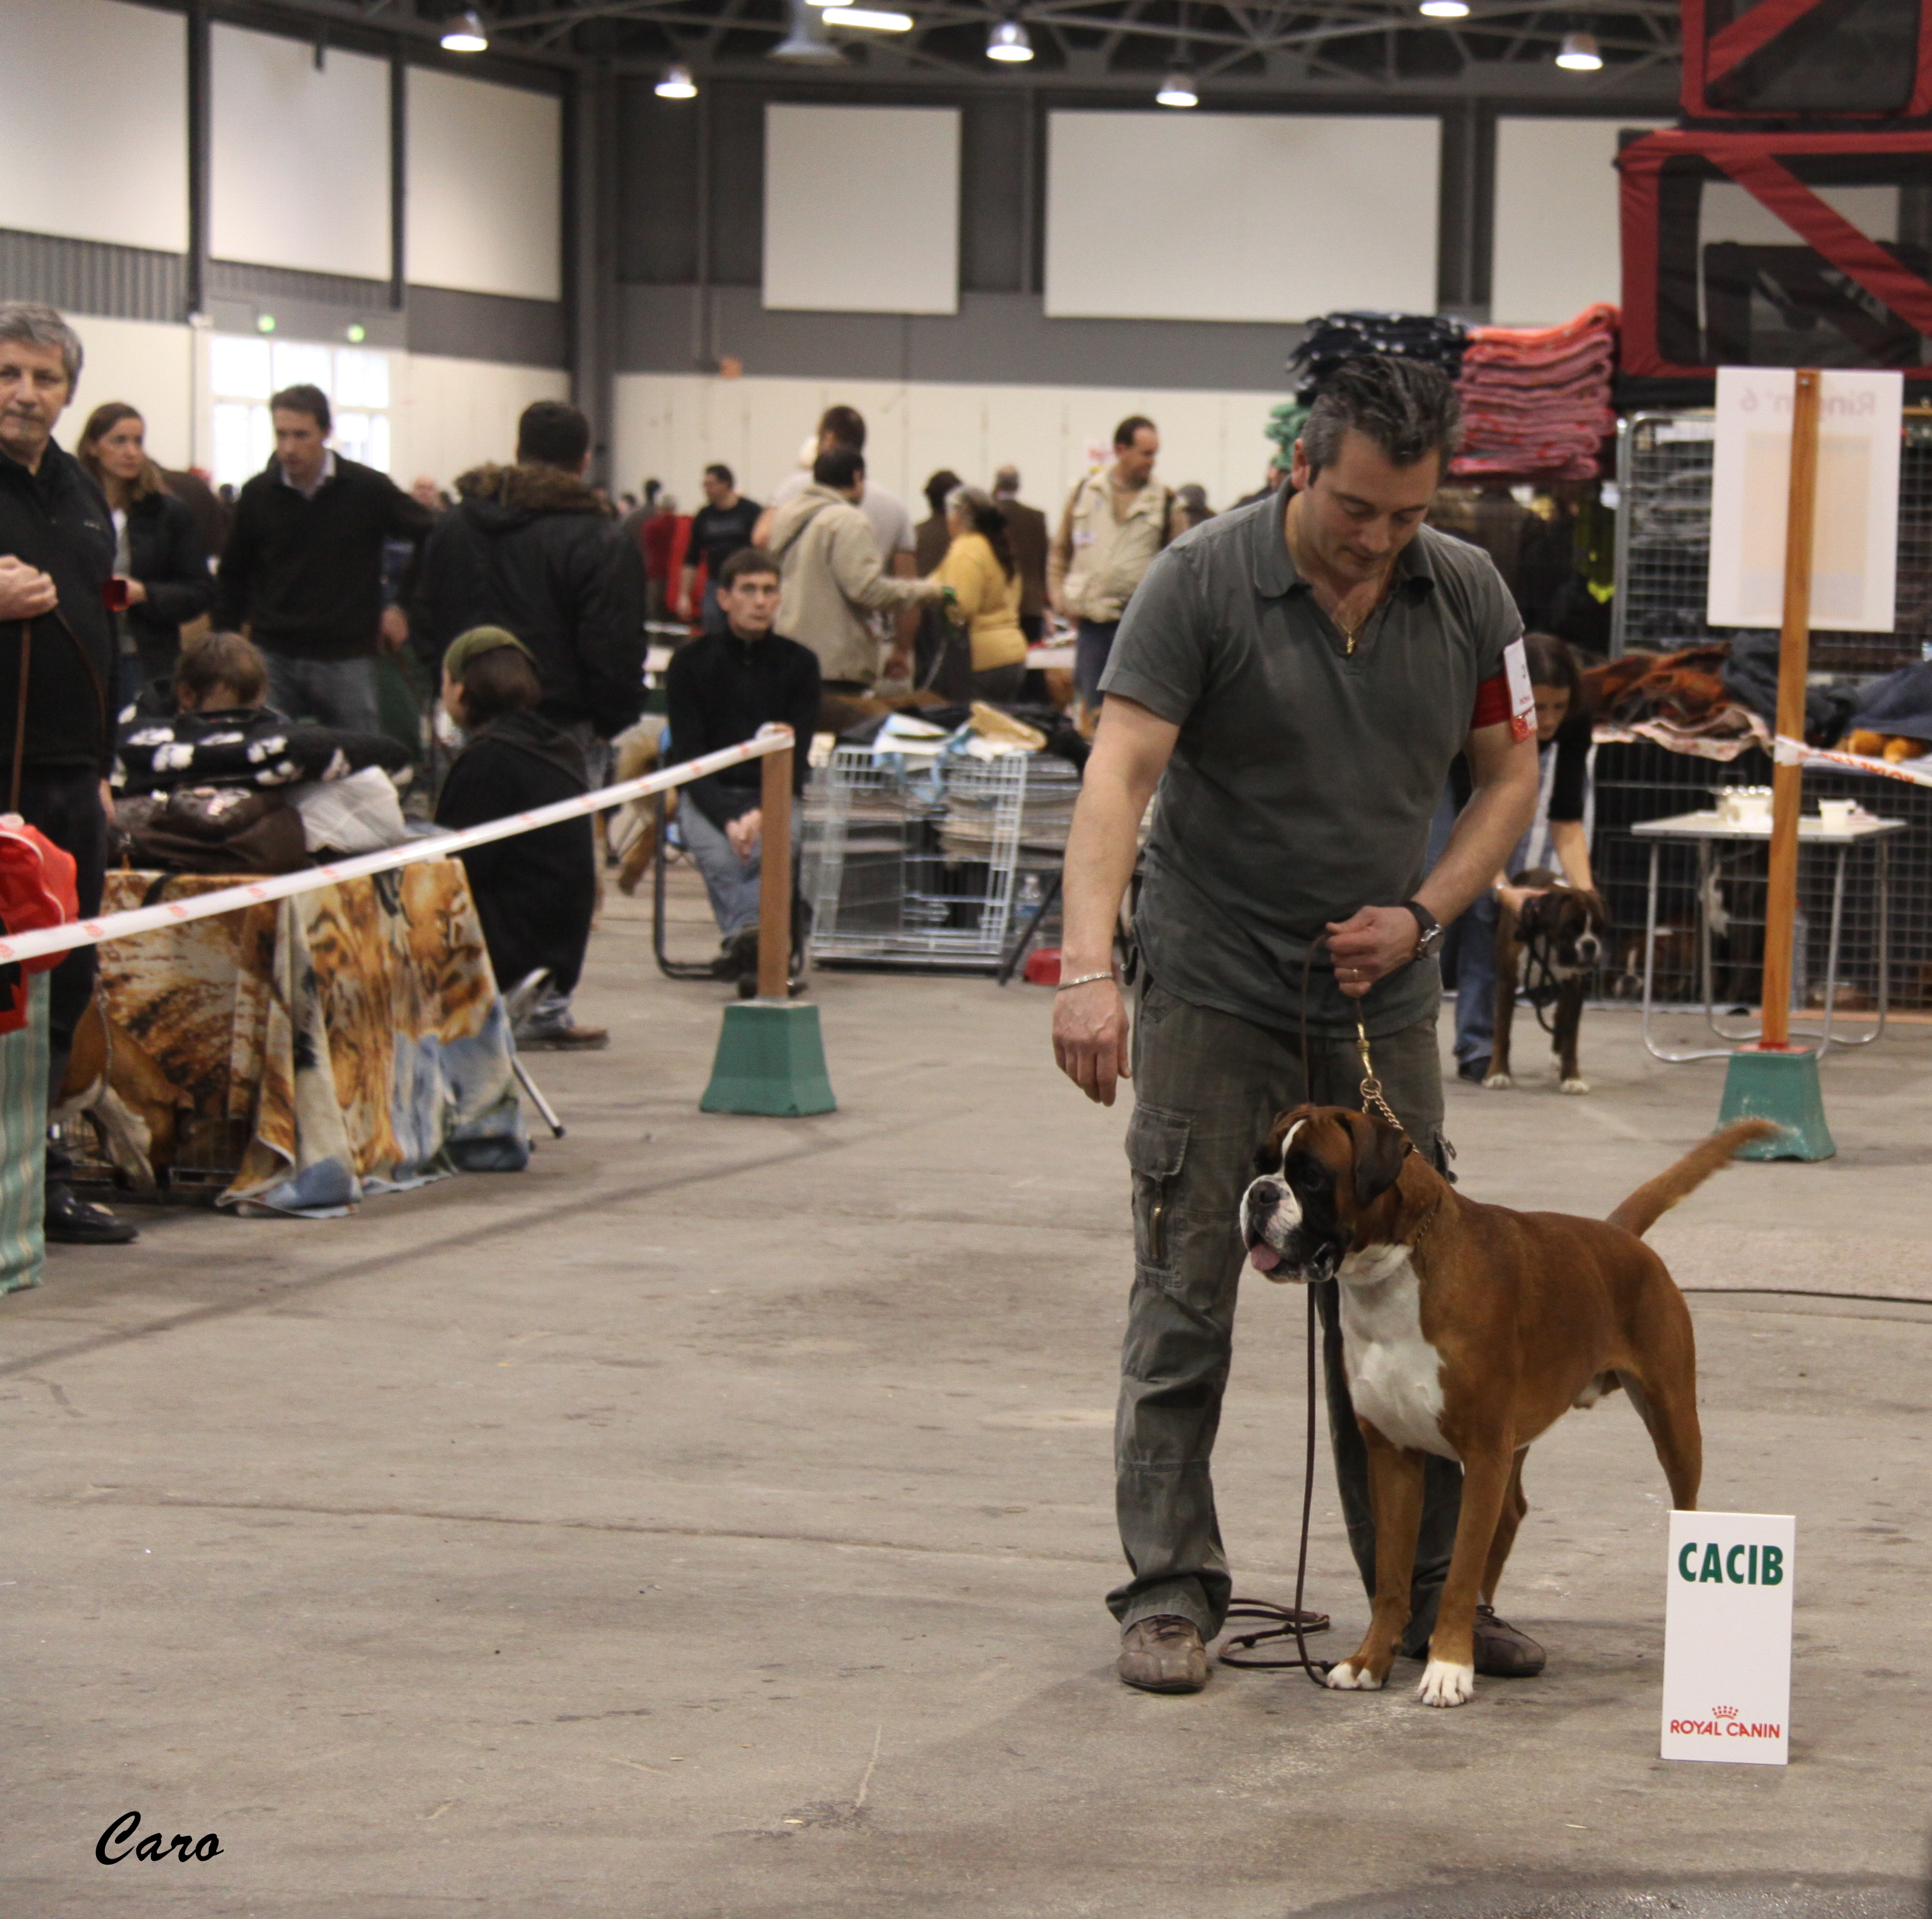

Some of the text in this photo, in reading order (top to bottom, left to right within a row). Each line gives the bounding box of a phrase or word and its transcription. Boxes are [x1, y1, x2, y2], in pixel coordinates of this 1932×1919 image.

[1678, 1542, 1784, 1586] CACIB
[1670, 1719, 1781, 1739] ROYAL CANIN
